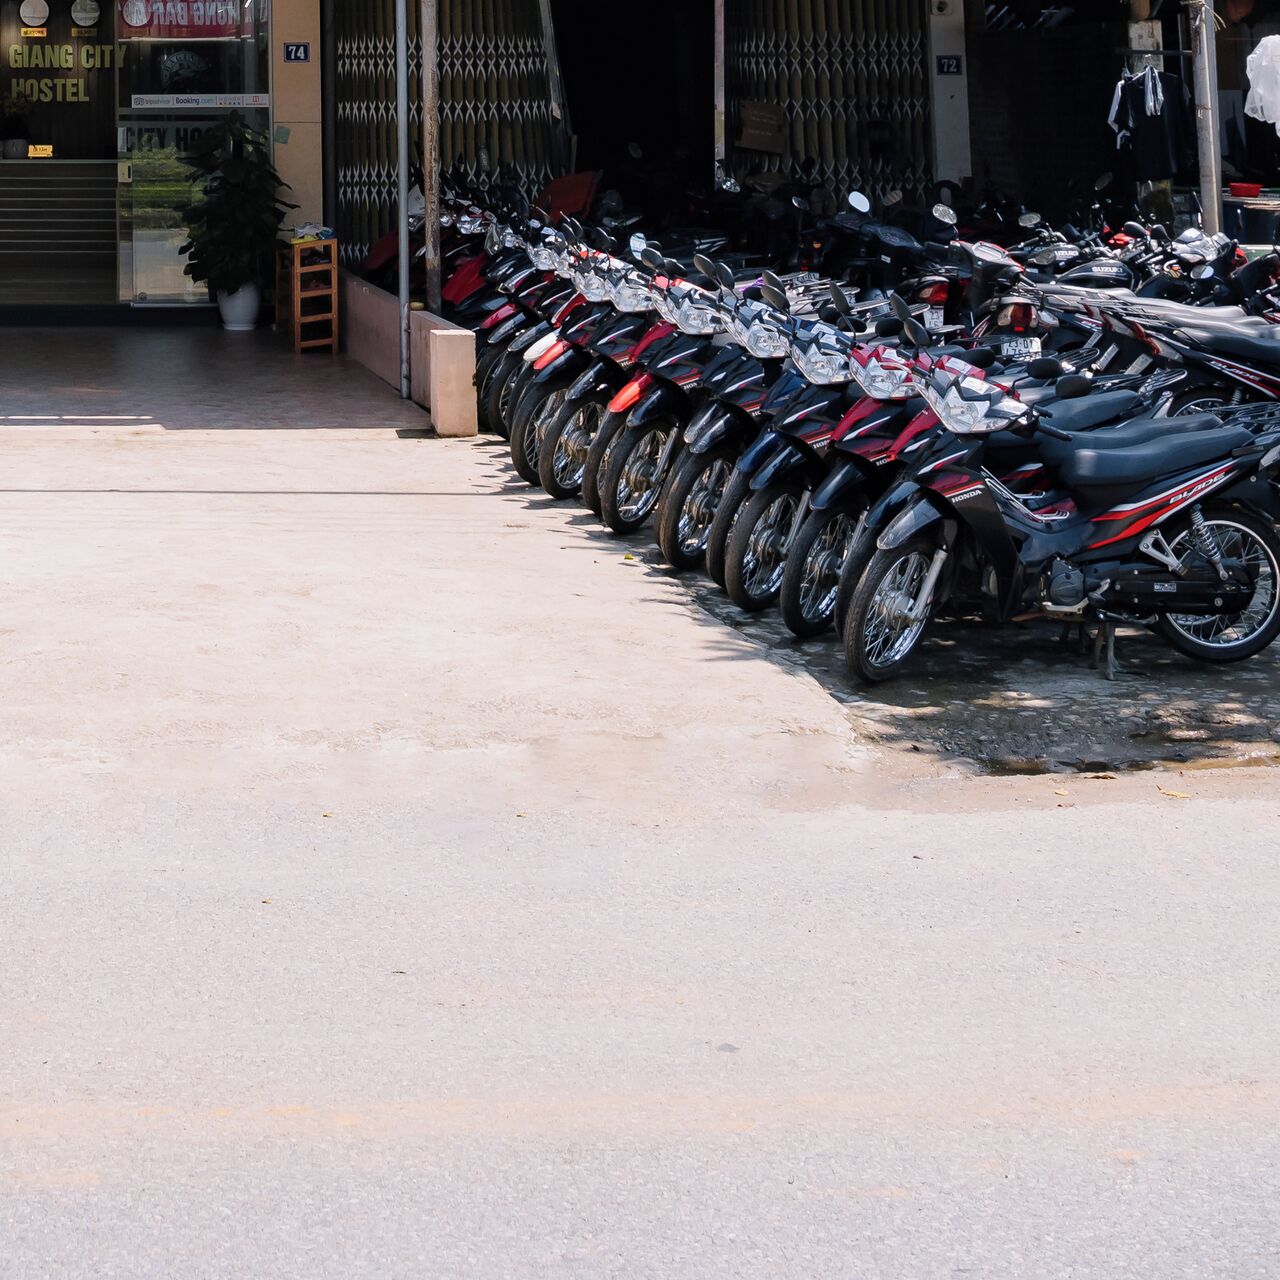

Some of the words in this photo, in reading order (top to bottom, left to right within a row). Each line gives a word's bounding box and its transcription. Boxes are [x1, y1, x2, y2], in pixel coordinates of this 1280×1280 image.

[8, 44, 73, 69] GIANG
[80, 44, 128, 69] CITY
[288, 45, 305, 60] 74
[941, 58, 957, 72] 72
[10, 78, 90, 103] HOSTEL
[951, 488, 983, 503] HONDA
[1169, 471, 1225, 504] BLADE
